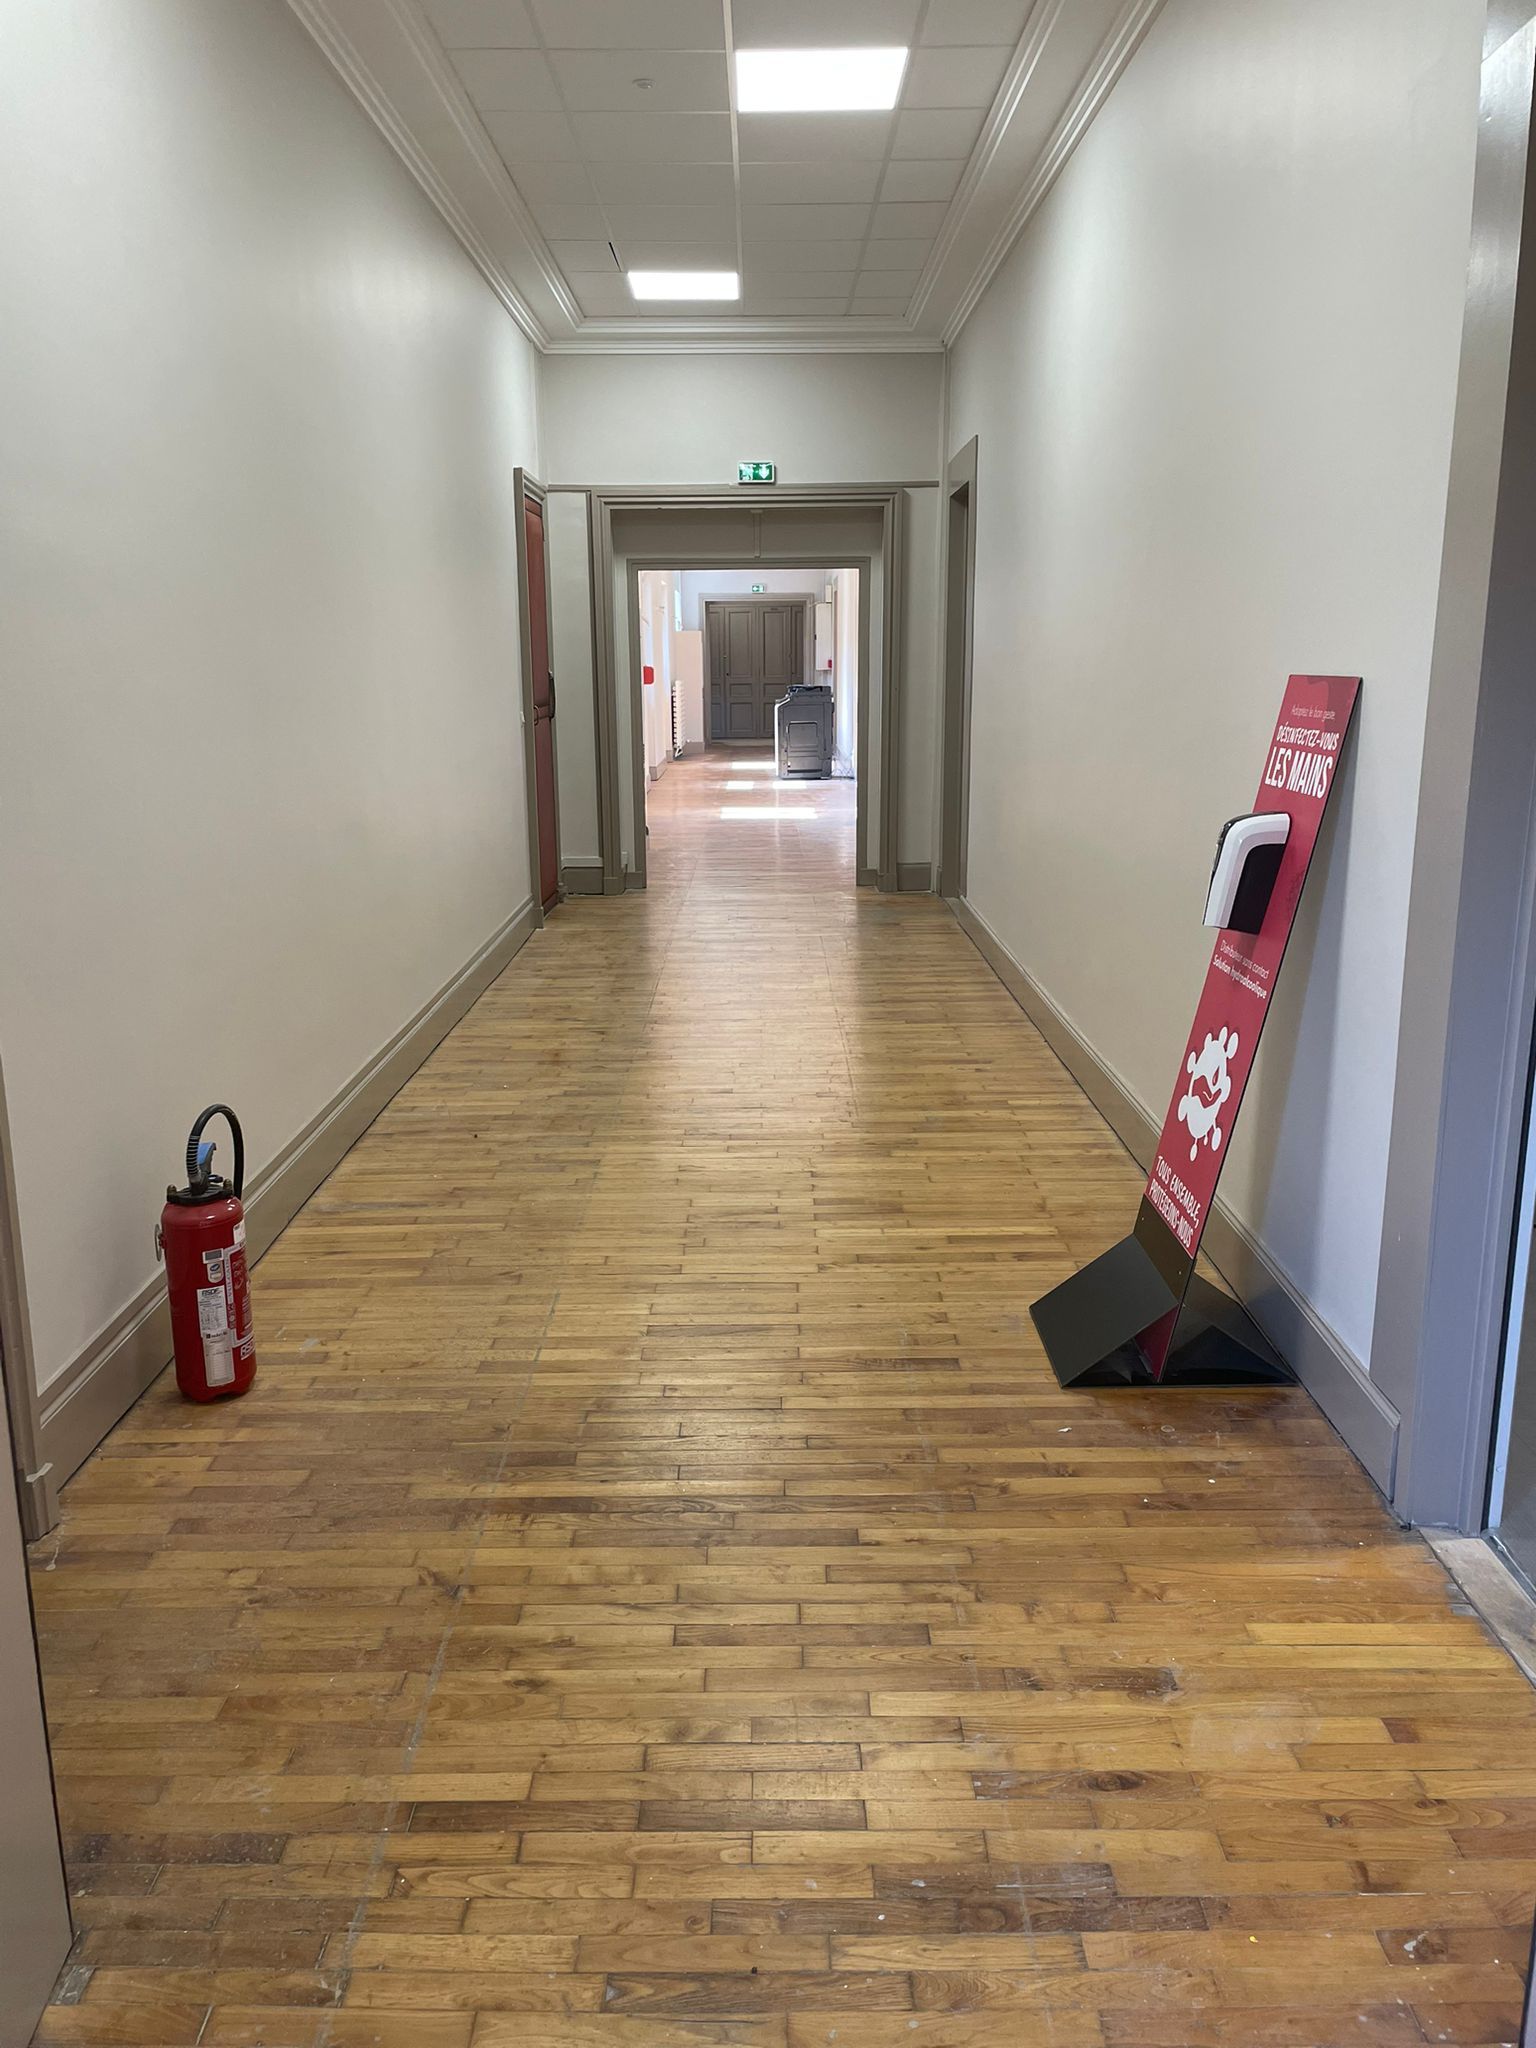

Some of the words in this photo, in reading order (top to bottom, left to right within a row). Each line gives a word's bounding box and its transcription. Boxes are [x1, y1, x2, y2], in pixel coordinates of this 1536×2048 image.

[1277, 722, 1339, 750] DÉSINFECTEZ-VOUS
[1265, 746, 1292, 789] LES
[1286, 750, 1334, 799] MAINS
[1213, 954, 1231, 974] Solution
[1149, 1179, 1193, 1248] PROTÉGEONS-NOUS
[1156, 1155, 1172, 1185] TOUS
[1169, 1173, 1202, 1229] ENSEMBLE,
